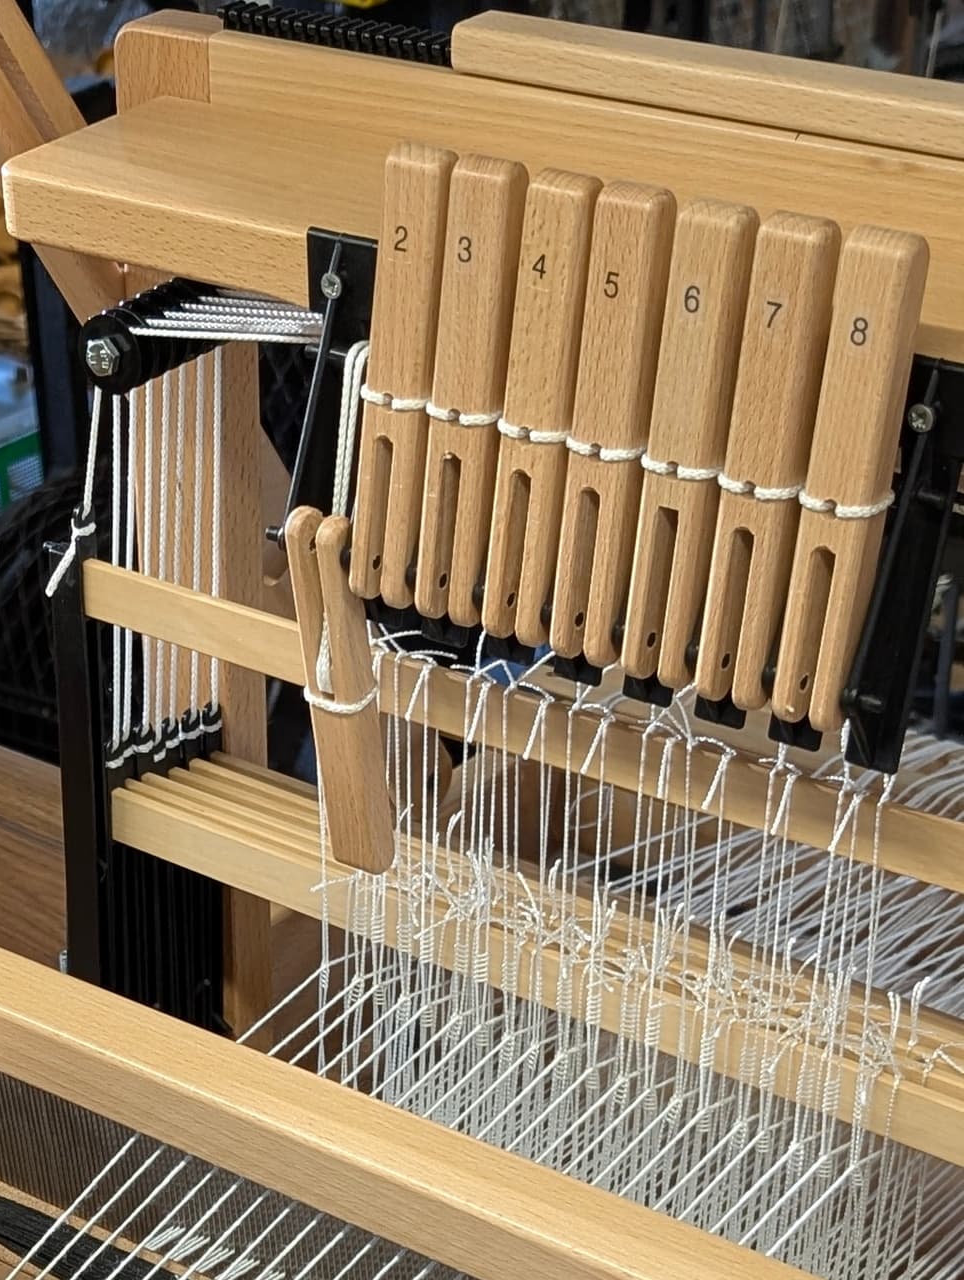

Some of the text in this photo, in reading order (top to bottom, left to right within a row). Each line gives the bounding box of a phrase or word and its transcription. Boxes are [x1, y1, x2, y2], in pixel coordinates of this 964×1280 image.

[393, 225, 408, 253] 2
[457, 236, 472, 263] 3
[532, 254, 546, 280] 4
[603, 271, 620, 299] 5
[684, 285, 701, 314] 6
[766, 300, 783, 329] 7
[850, 317, 869, 346] 8
